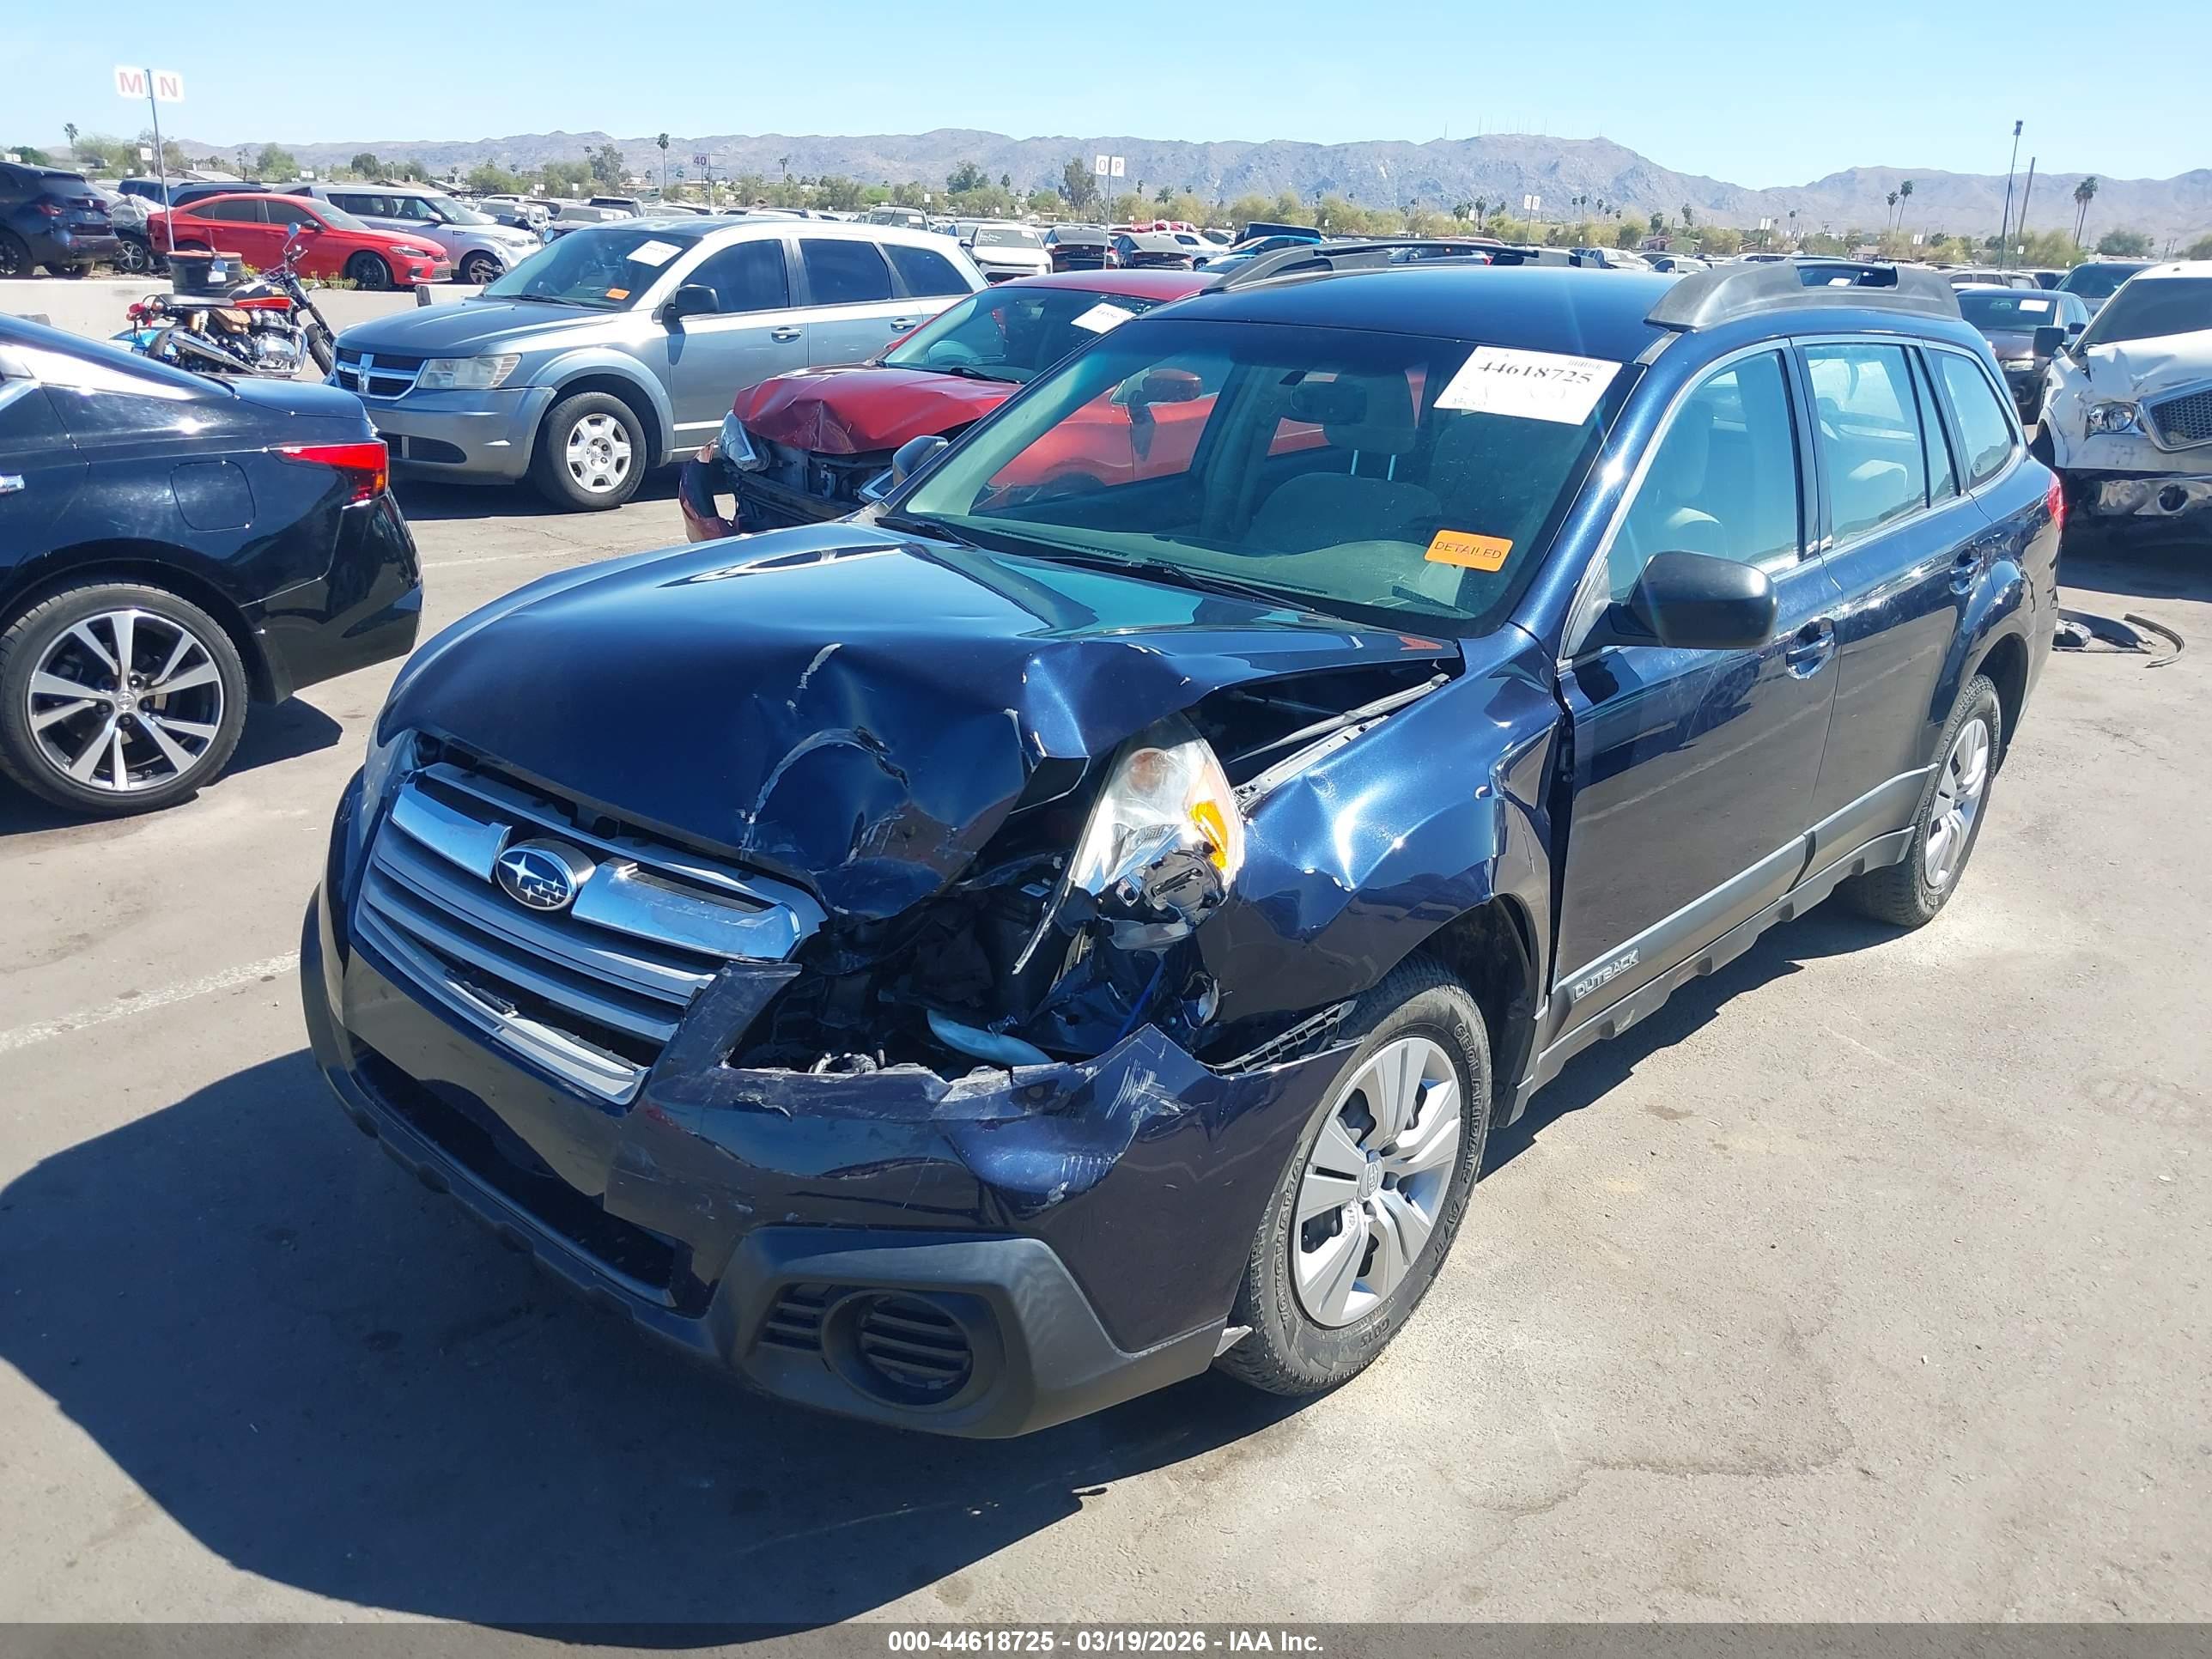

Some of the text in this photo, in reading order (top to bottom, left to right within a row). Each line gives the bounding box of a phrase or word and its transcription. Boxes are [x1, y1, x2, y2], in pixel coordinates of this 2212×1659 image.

[118, 71, 143, 94] M
[159, 76, 178, 97] N
[694, 155, 707, 166] 40
[1114, 161, 1121, 173] P
[1478, 361, 1595, 384] 44618725
[1434, 540, 1502, 559] DETAILED
[1574, 947, 1639, 1000] OUTBACK
[1454, 1022, 1482, 1183] GEOLANDAR
